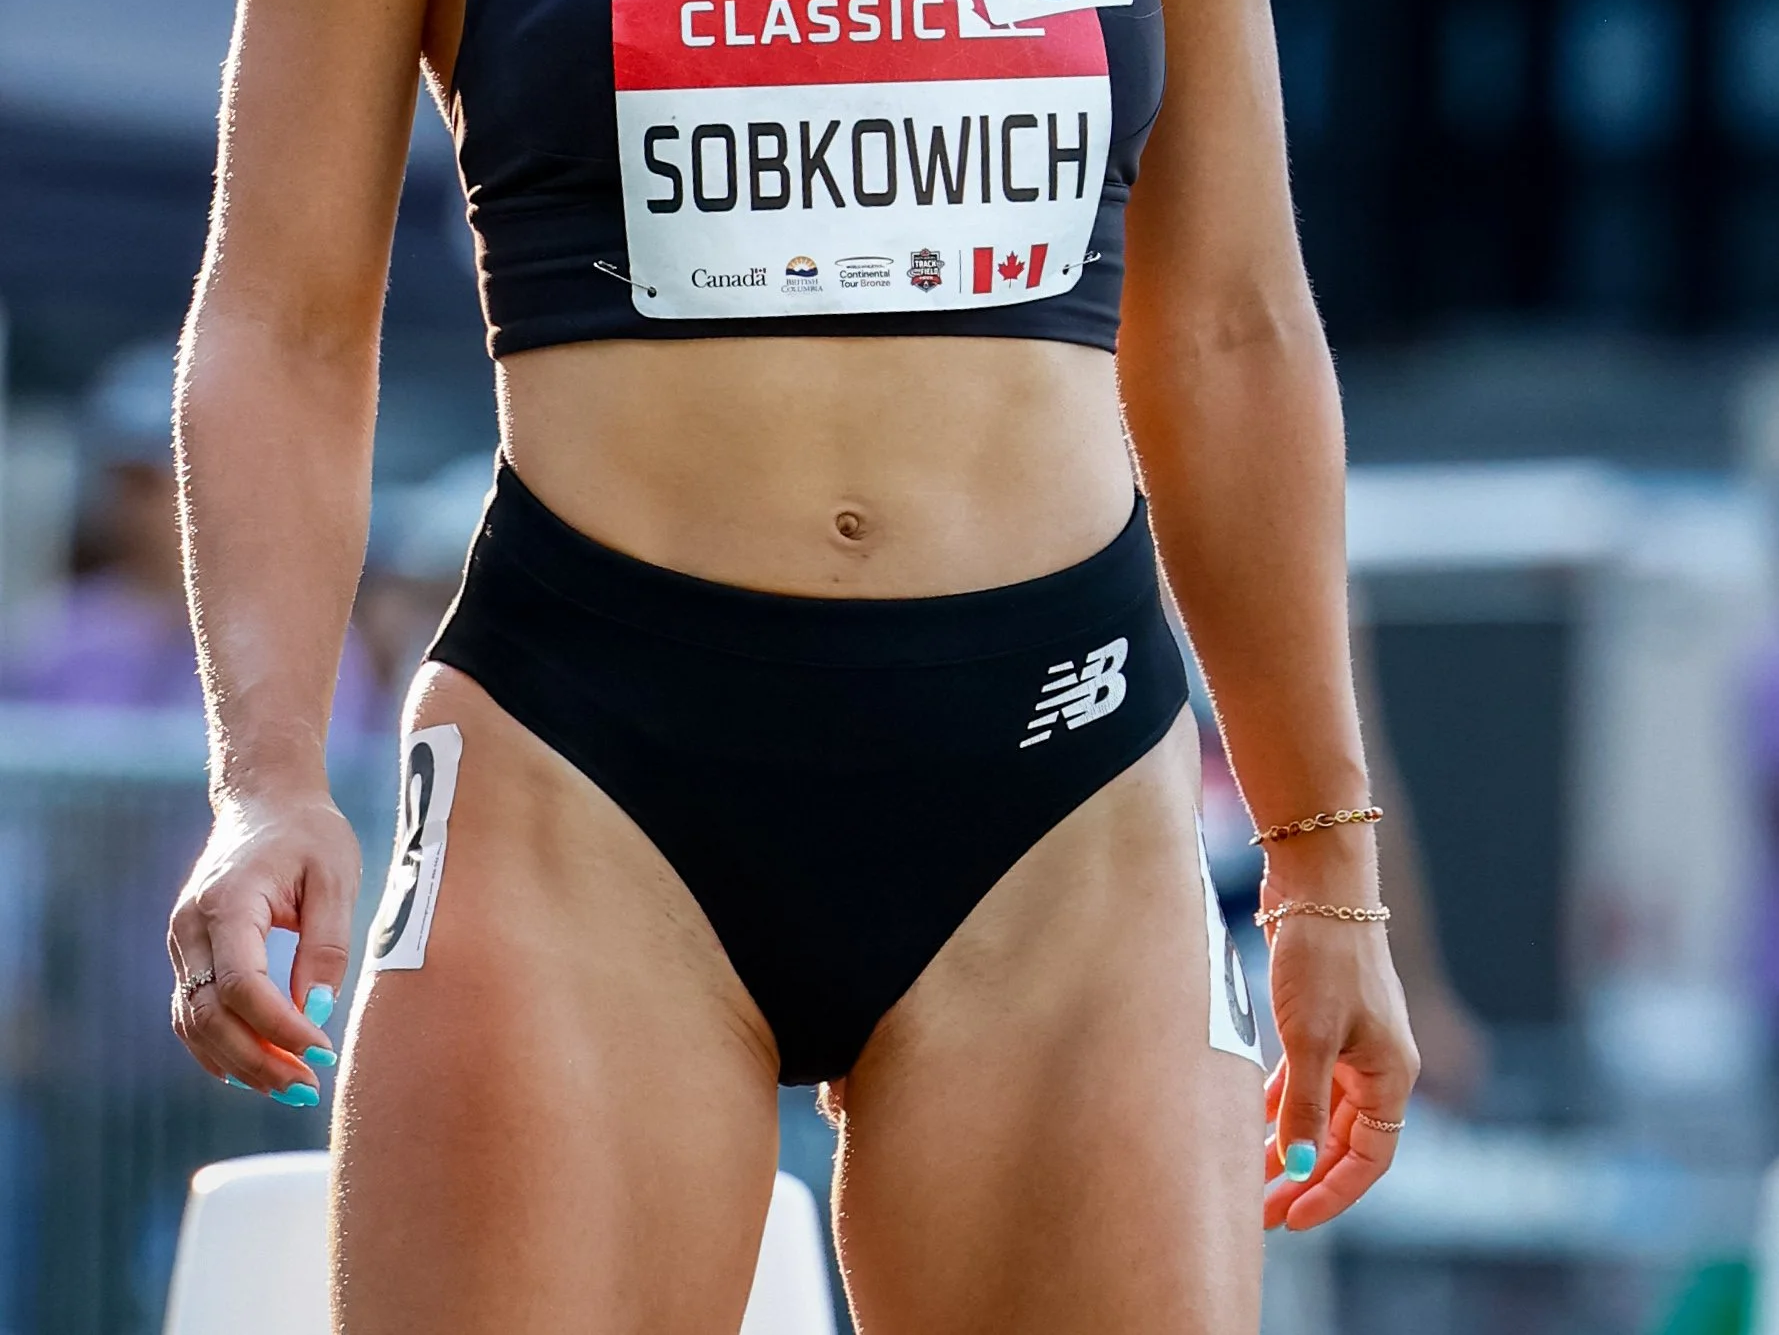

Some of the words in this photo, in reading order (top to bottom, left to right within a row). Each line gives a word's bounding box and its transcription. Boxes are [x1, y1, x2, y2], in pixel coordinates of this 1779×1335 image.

[643, 111, 1089, 215] SOBKOWICH
[914, 259, 938, 269] TRACK
[691, 267, 768, 289] Canada
[839, 269, 891, 280] Continental
[786, 278, 819, 286] BRITISH
[840, 279, 859, 288] Tour
[860, 278, 891, 288] Bronze
